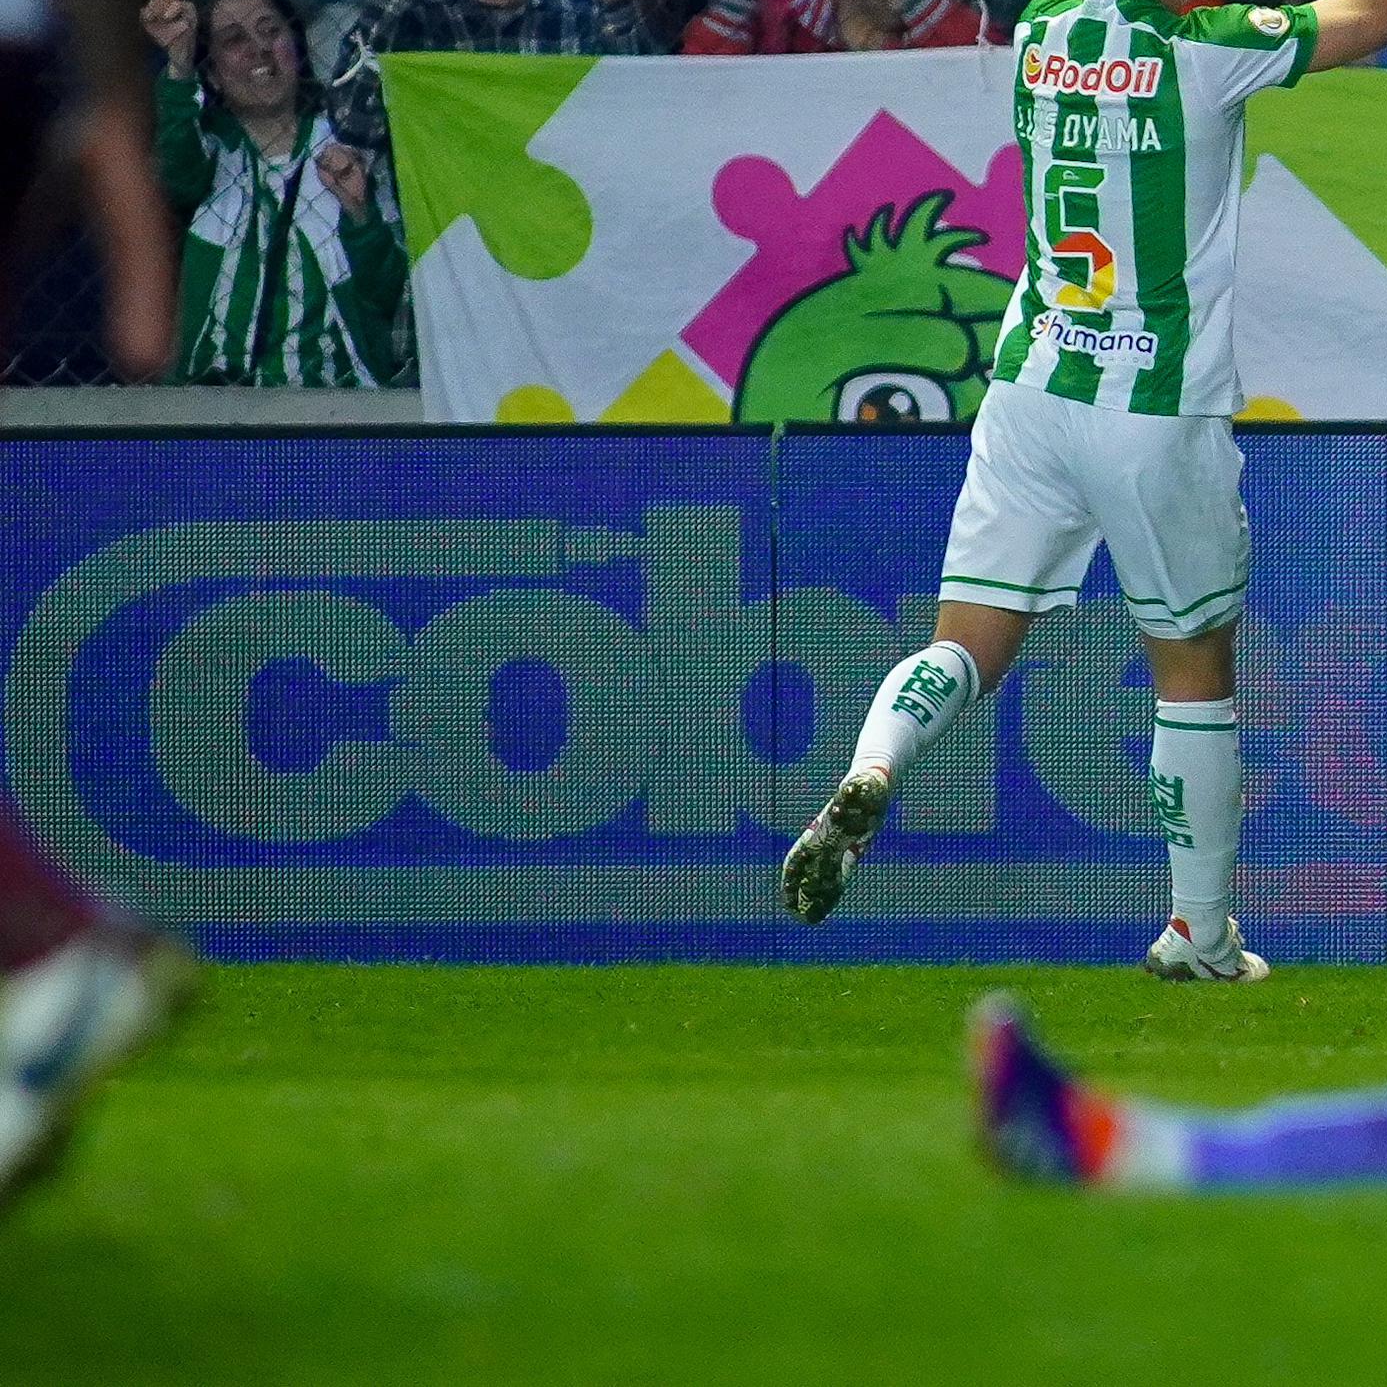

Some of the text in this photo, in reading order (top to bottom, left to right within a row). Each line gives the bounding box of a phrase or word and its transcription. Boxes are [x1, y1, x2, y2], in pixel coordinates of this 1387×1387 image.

[1042, 54, 1160, 94] RodOil
[1062, 113, 1163, 153] OYAMA
[1039, 160, 1119, 315] 5
